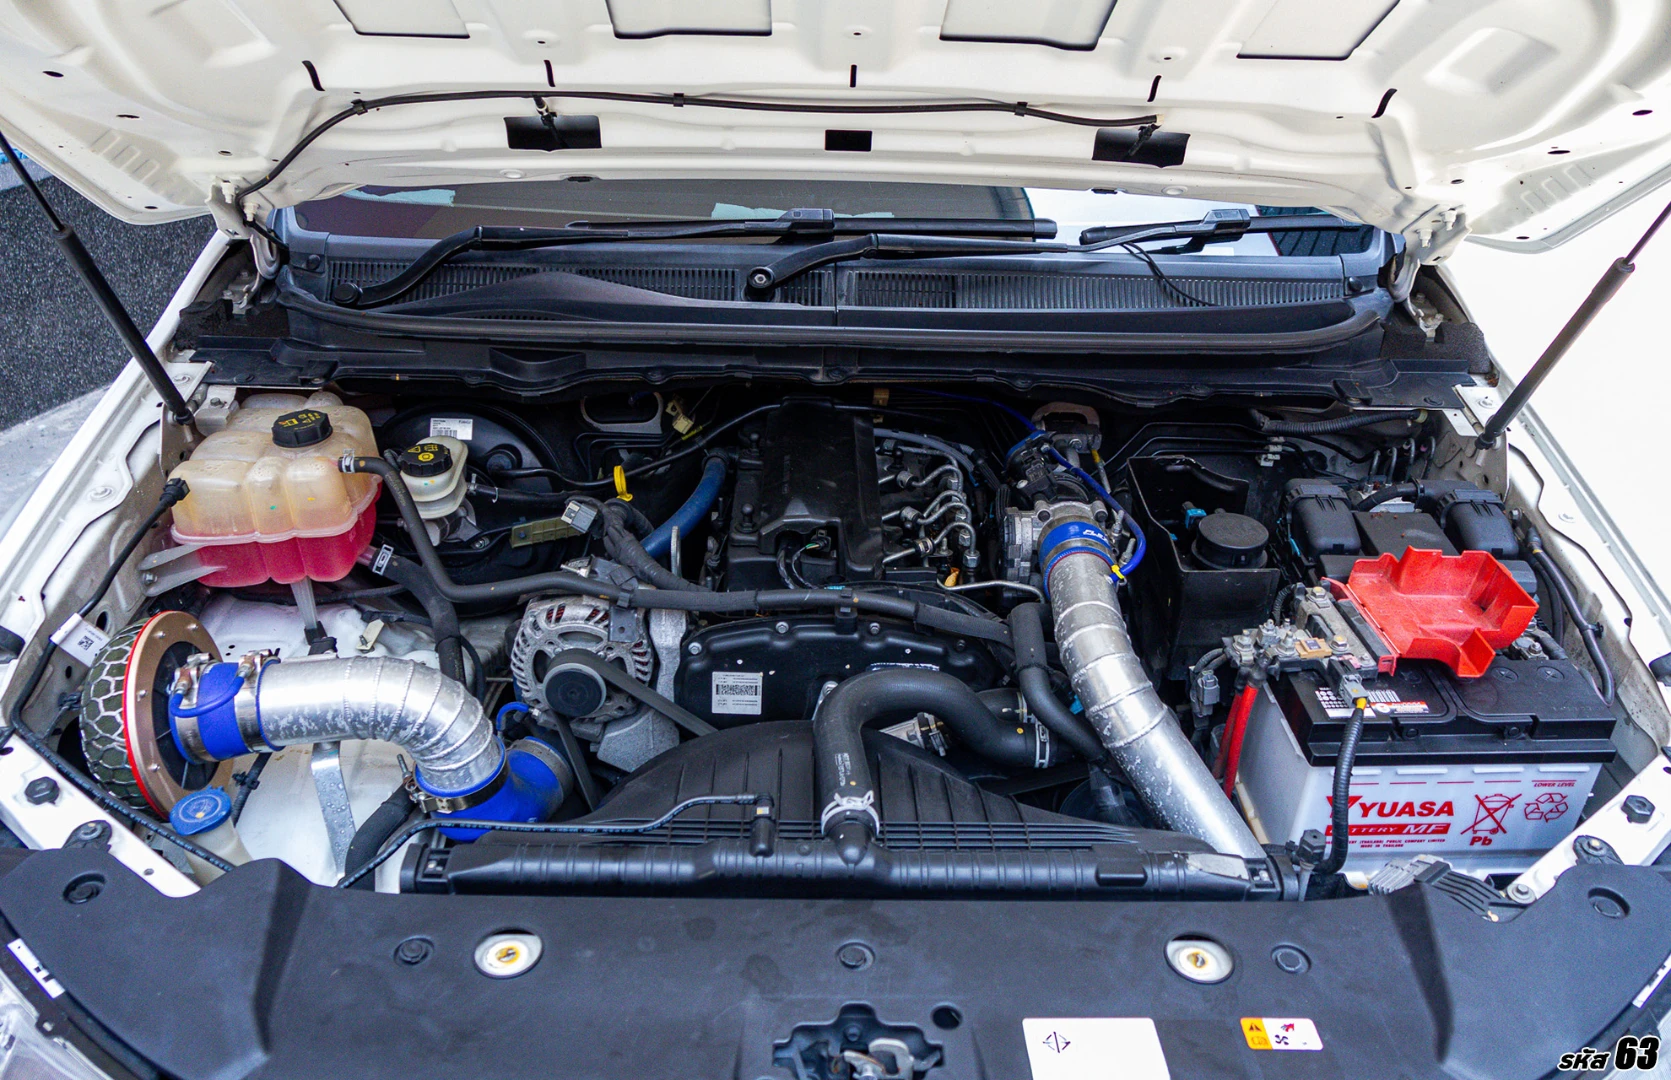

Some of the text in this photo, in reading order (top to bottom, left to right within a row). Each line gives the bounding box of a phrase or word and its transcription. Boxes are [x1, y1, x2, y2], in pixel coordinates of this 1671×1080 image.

[1359, 801, 1454, 817] YUASA
[1402, 824, 1448, 834] MF
[1469, 836, 1493, 846] Pb
